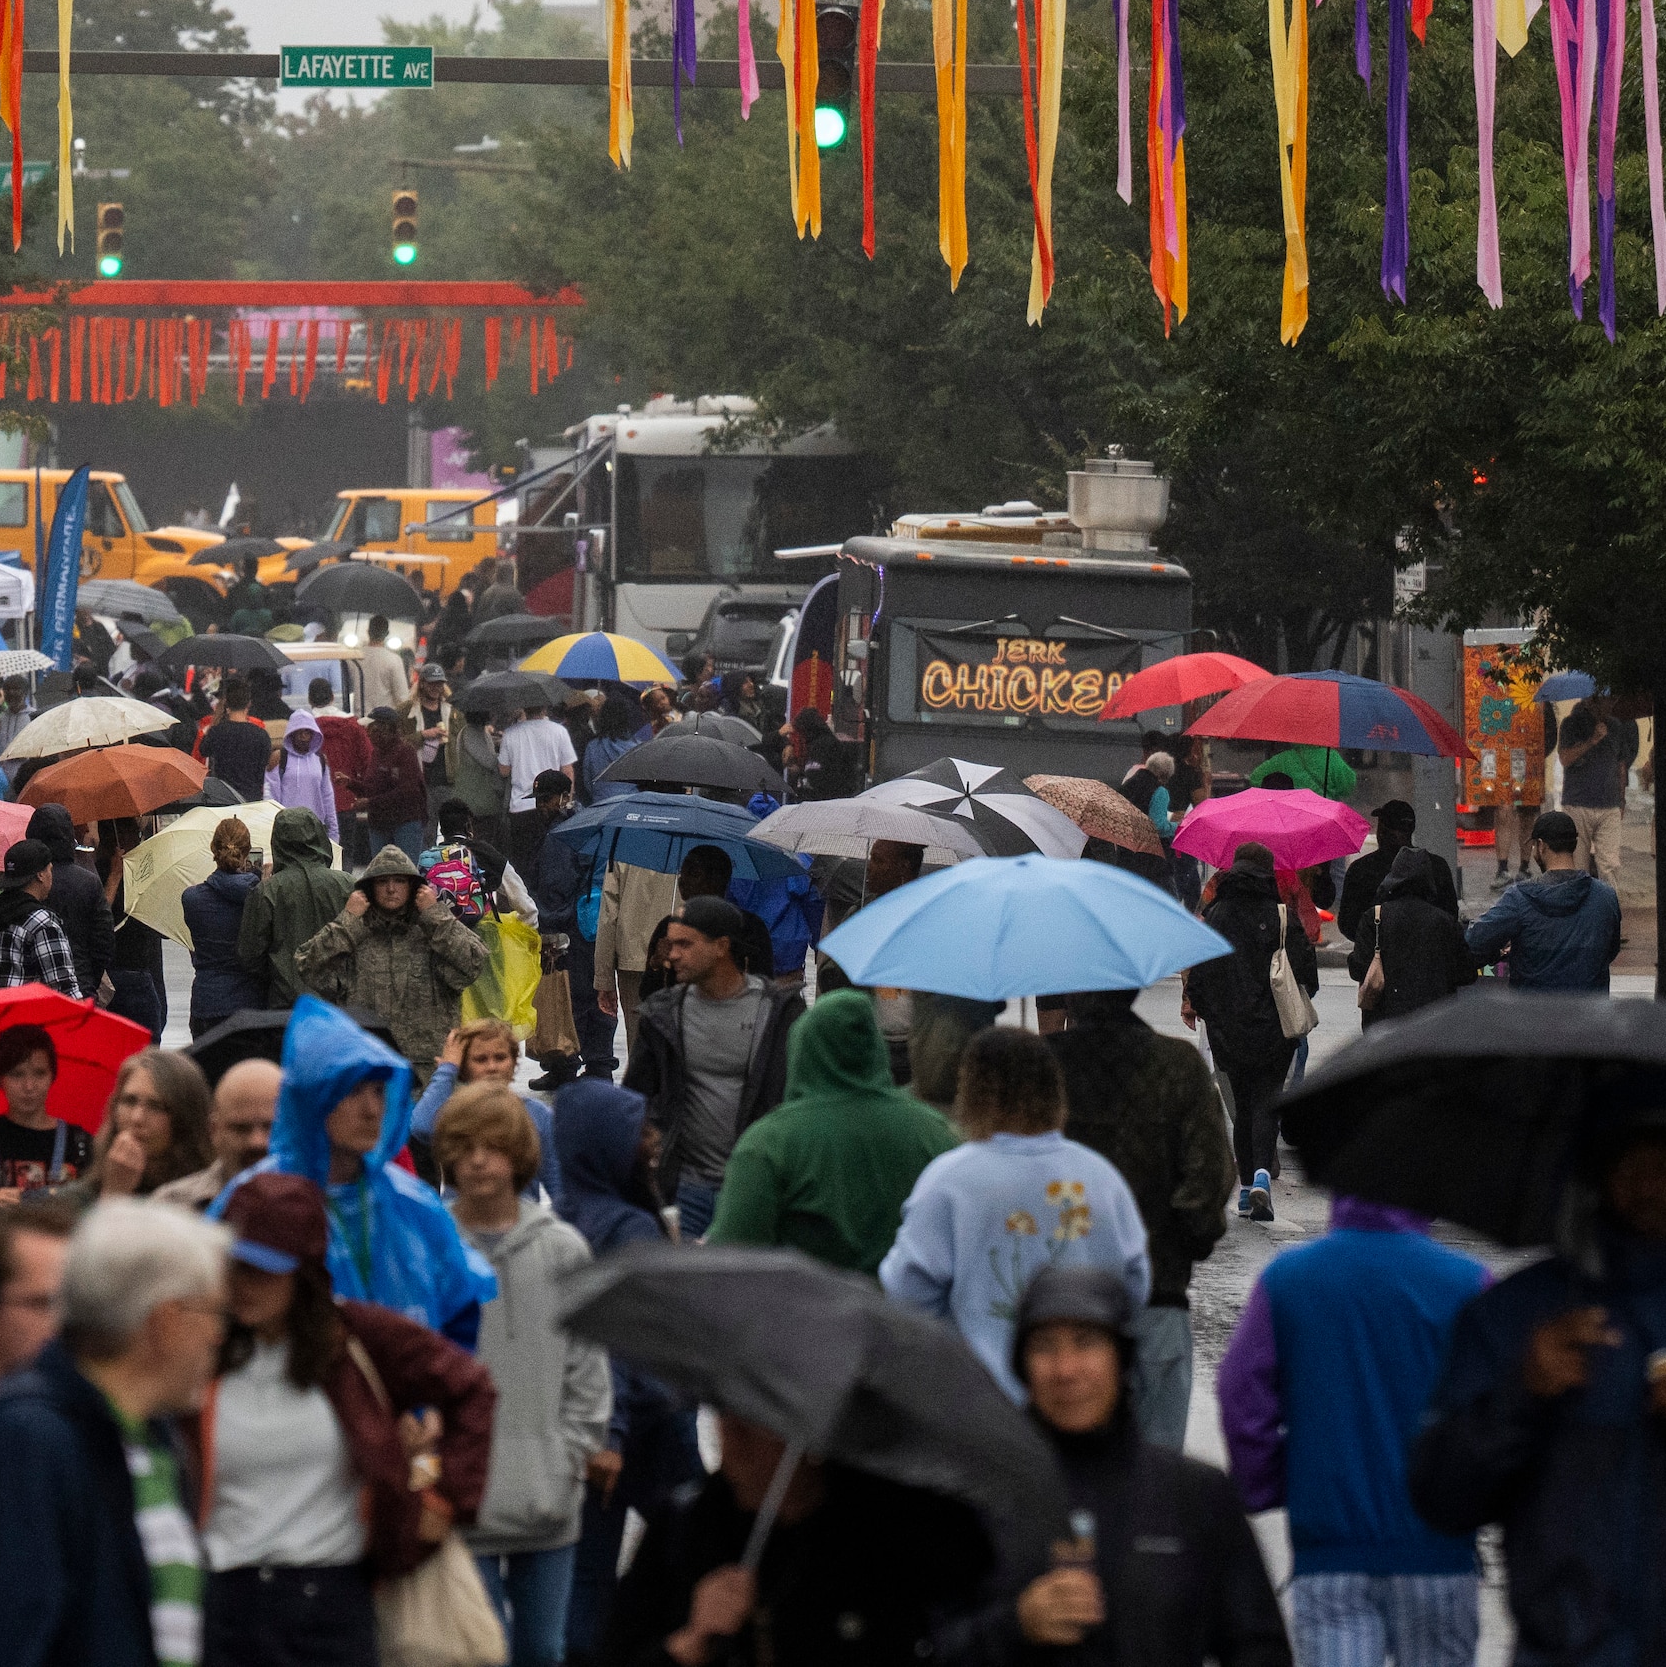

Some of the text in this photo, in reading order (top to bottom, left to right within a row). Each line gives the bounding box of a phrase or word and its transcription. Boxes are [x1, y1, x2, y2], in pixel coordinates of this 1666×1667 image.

[284, 55, 429, 79] LAFAYETTE AVE
[992, 637, 1067, 664] JERK
